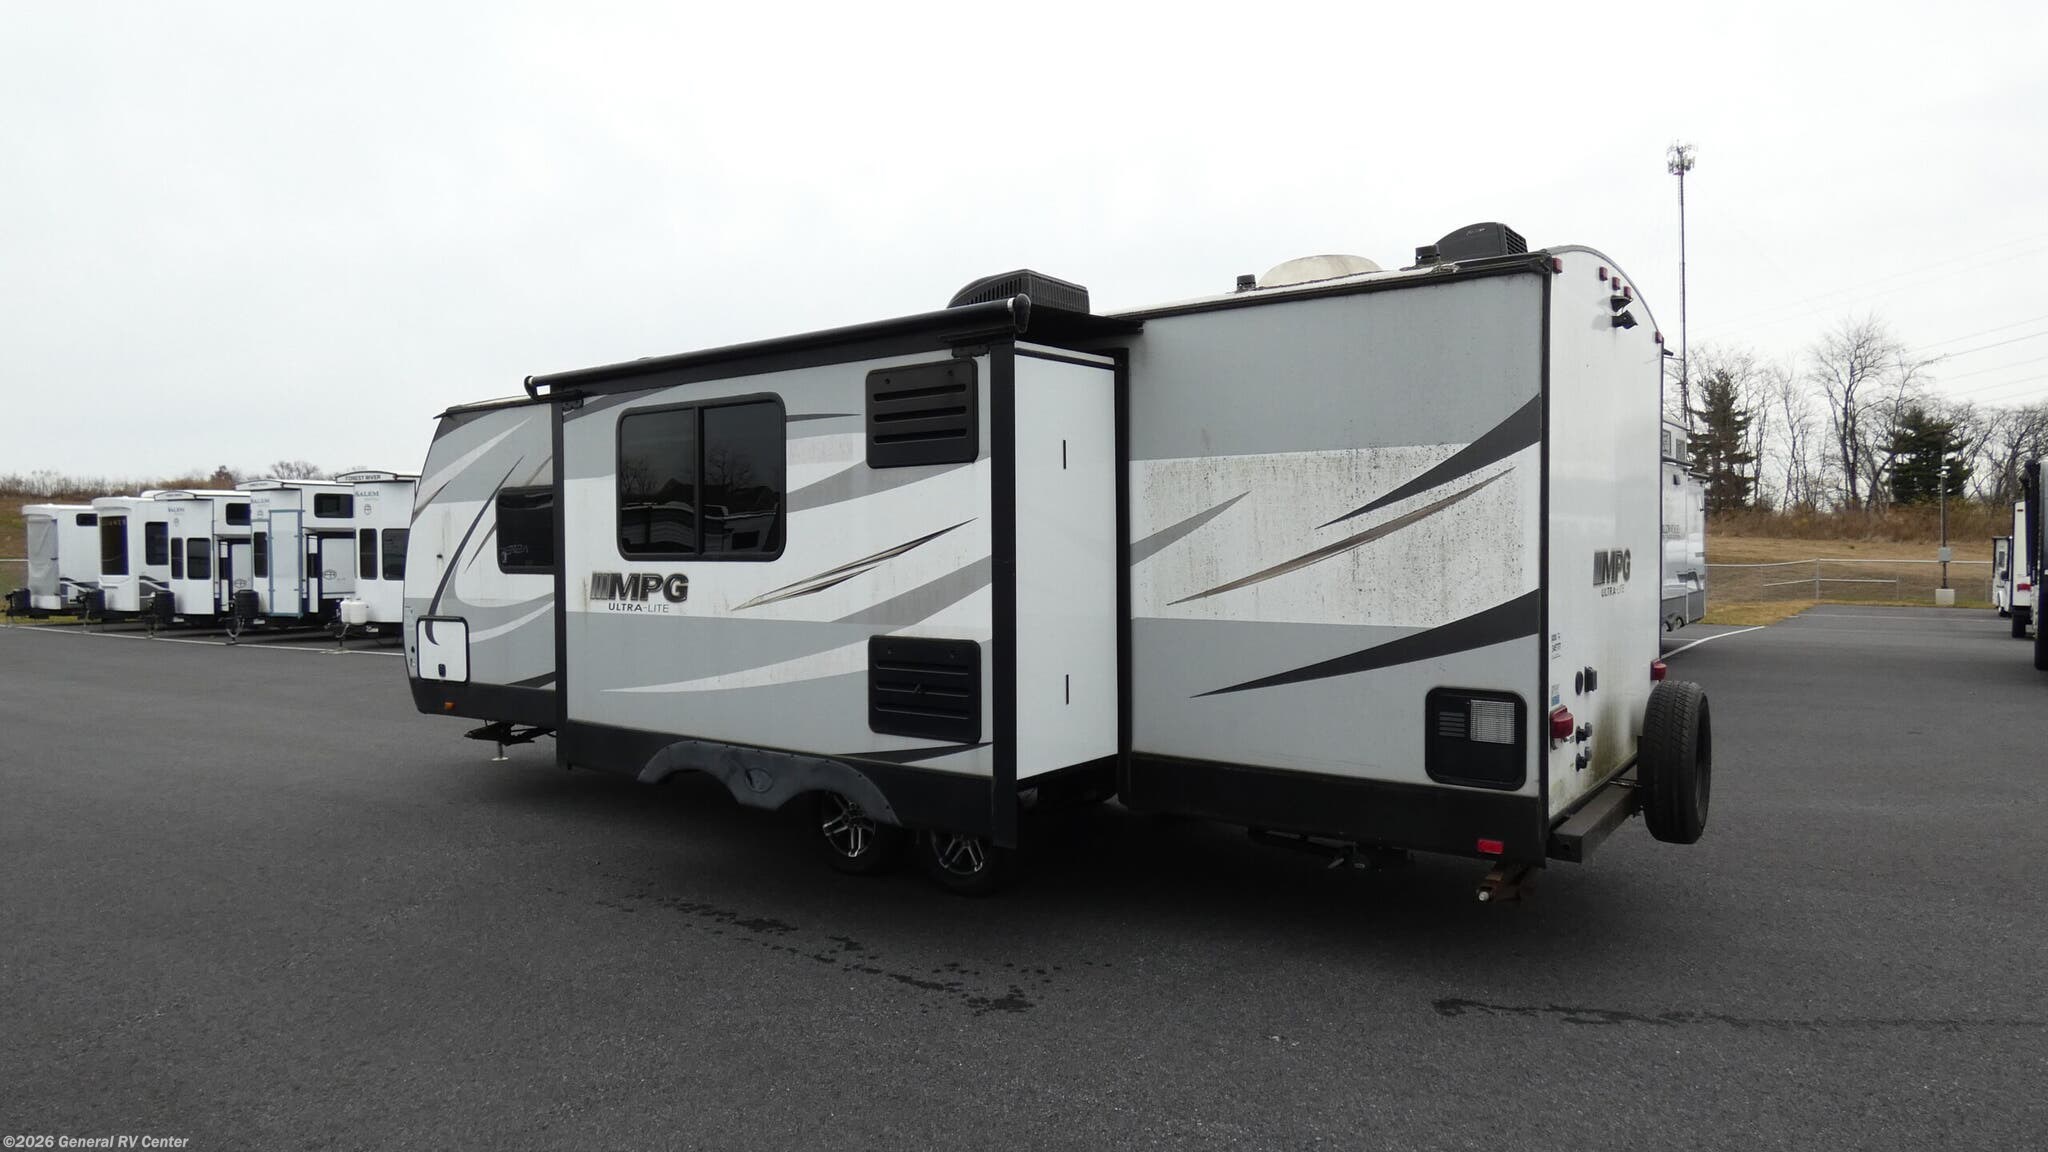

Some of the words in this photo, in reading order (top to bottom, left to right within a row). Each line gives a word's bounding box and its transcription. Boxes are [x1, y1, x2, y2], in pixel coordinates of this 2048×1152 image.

[1598, 549, 1631, 585] MPG
[605, 572, 689, 603] MPG
[608, 602, 670, 613] ULTRA-LITE
